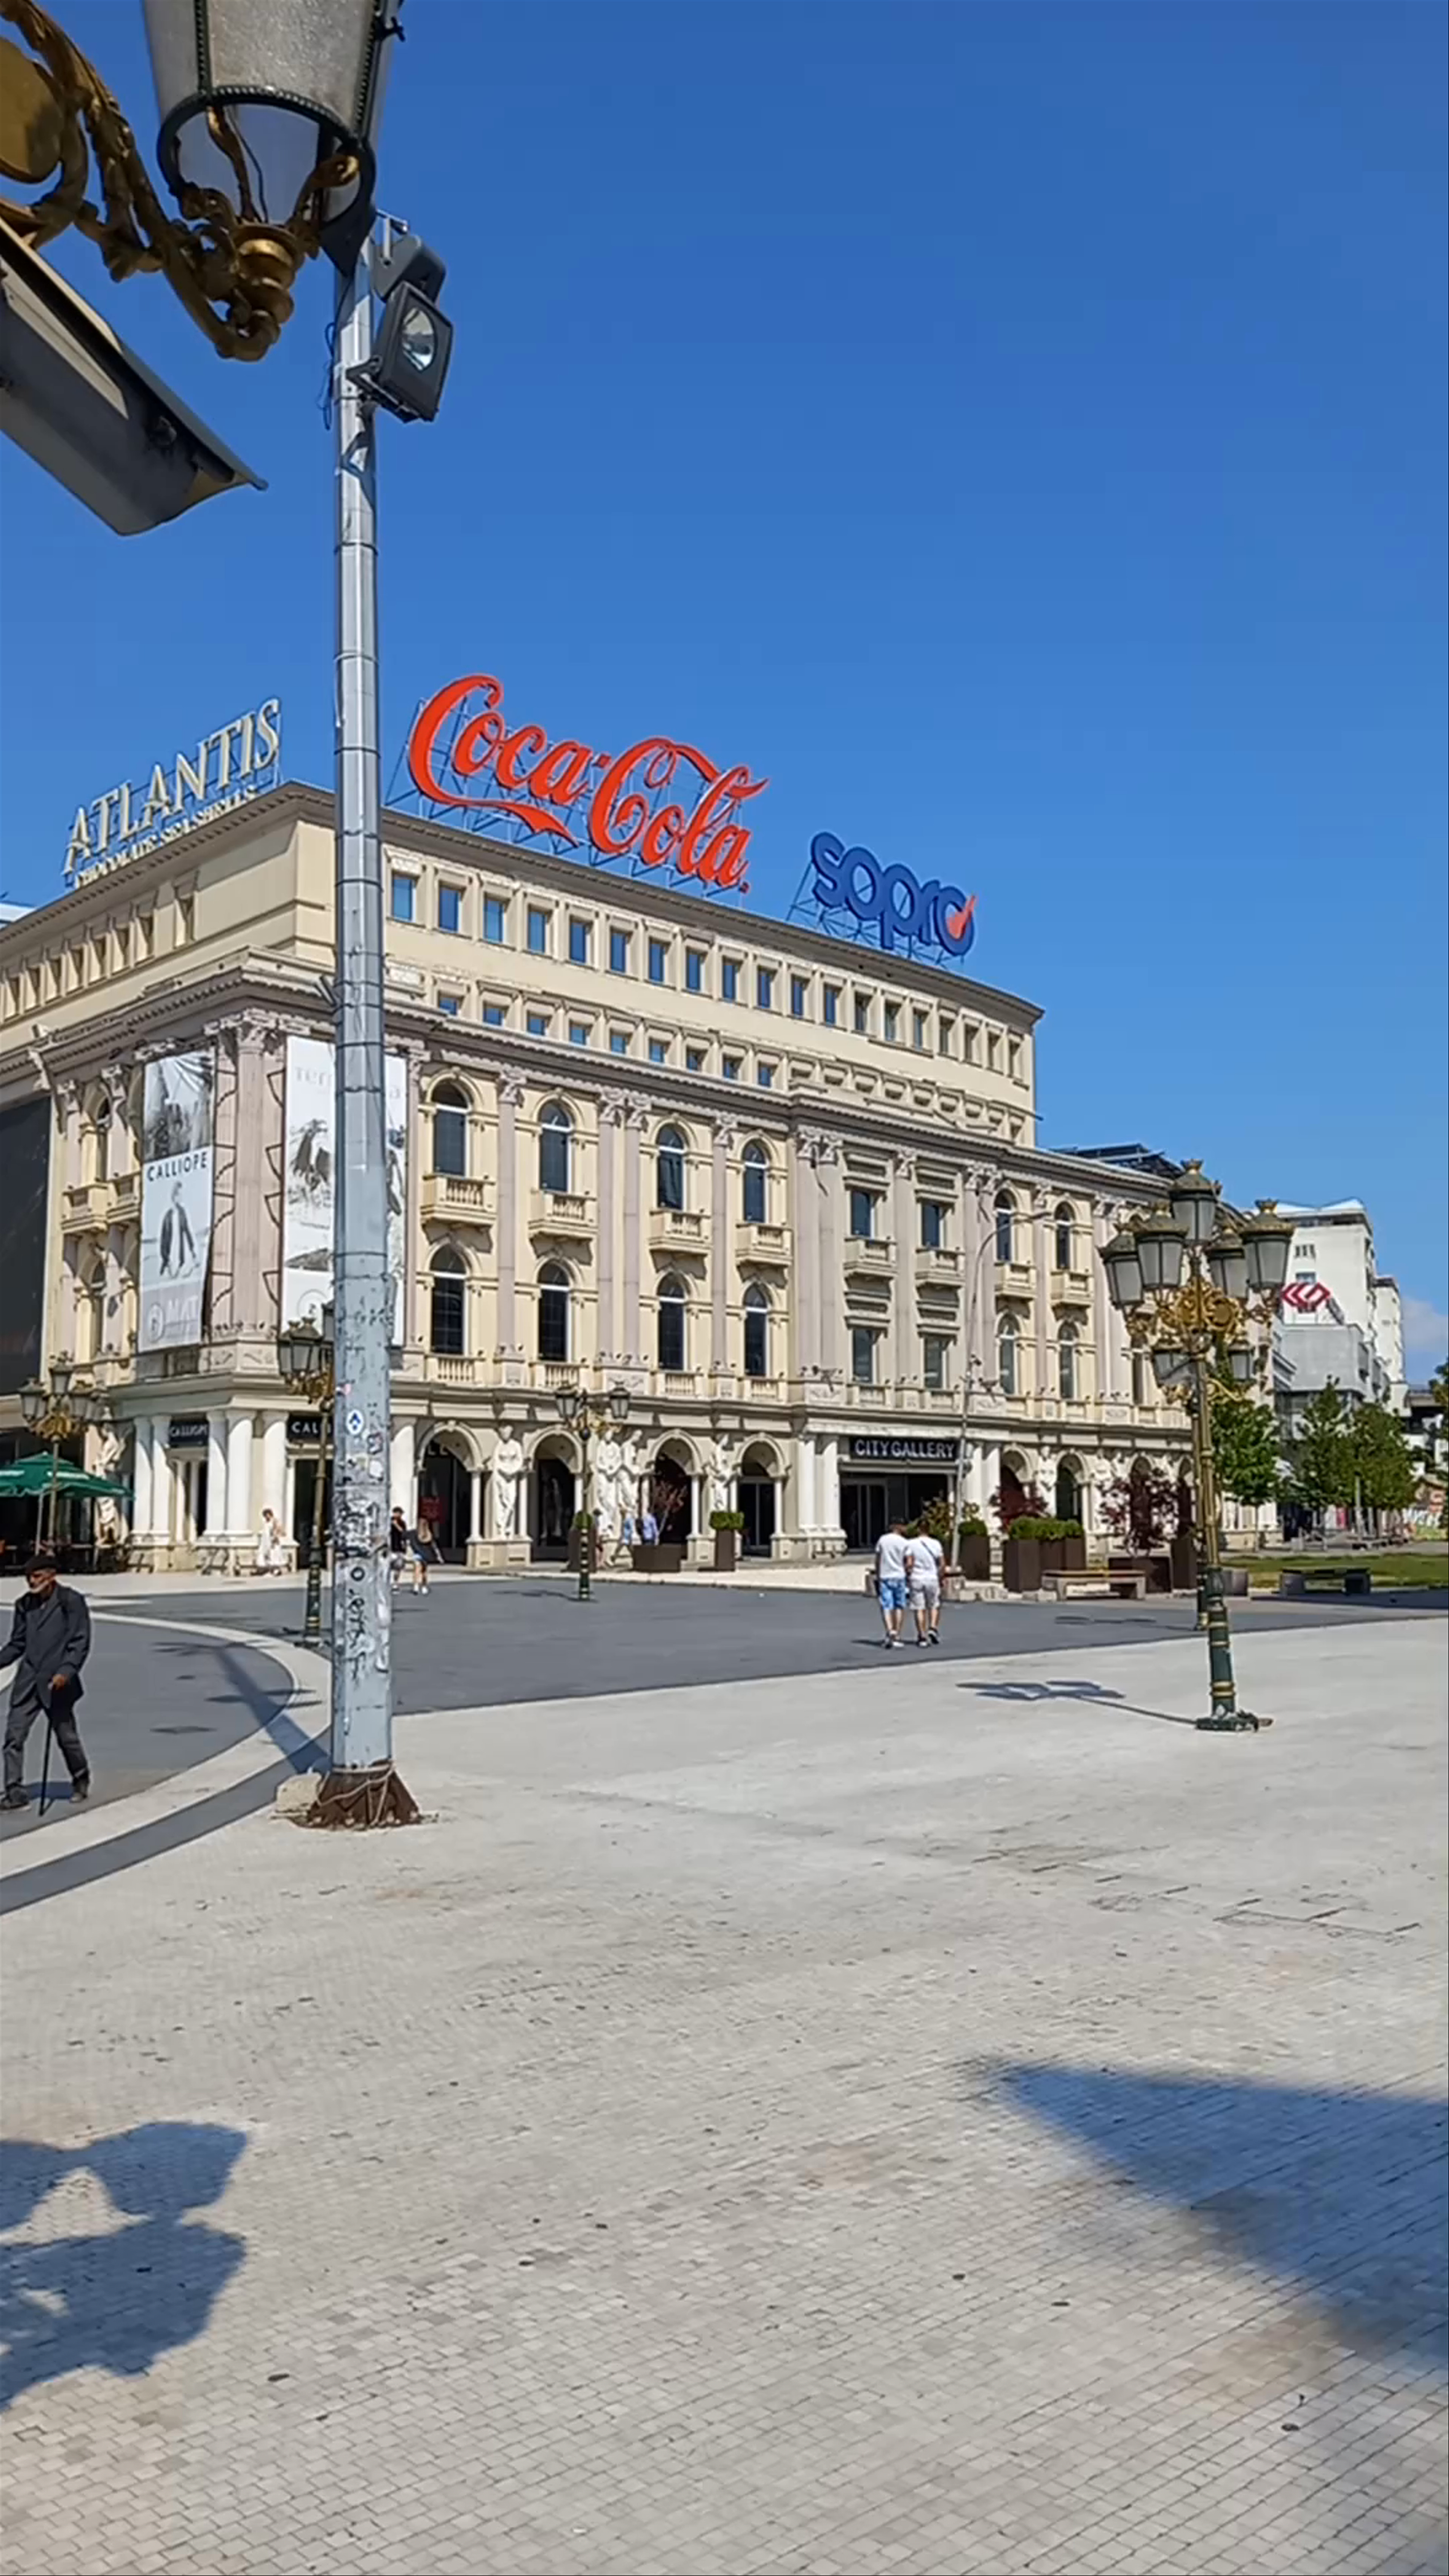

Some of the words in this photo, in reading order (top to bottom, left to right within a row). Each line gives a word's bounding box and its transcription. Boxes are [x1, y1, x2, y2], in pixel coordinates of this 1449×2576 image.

[62, 698, 278, 876] ATLANTIS
[408, 673, 769, 889] Coca-Cola
[811, 832, 975, 957] sopro
[147, 1152, 207, 1182] CALLIOPE
[855, 1439, 889, 1456] CITY
[891, 1441, 955, 1458] GALLERY
